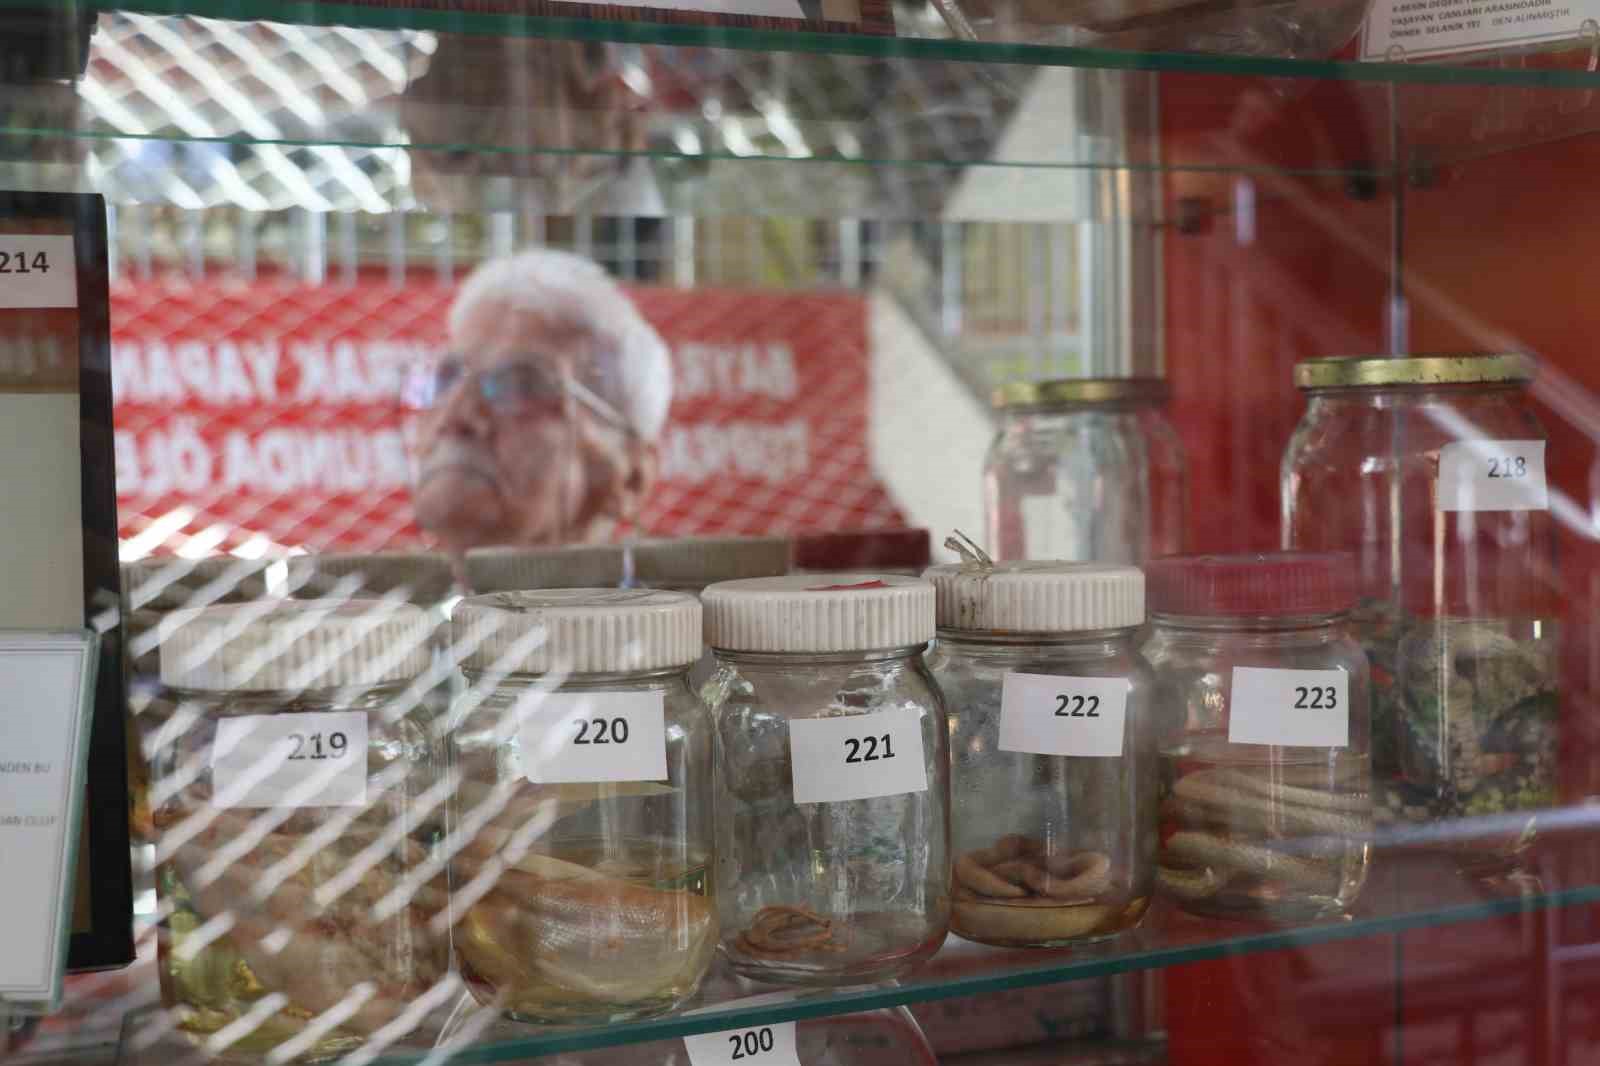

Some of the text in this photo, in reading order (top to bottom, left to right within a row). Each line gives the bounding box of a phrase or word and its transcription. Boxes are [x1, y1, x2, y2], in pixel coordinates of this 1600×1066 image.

[0, 251, 50, 273] 214
[1487, 455, 1526, 478] 218
[1055, 694, 1100, 718] 222
[1294, 686, 1338, 710] 223
[573, 717, 630, 745] 220
[286, 732, 348, 760] 219
[844, 734, 895, 764] 221
[728, 1027, 773, 1060] 200
